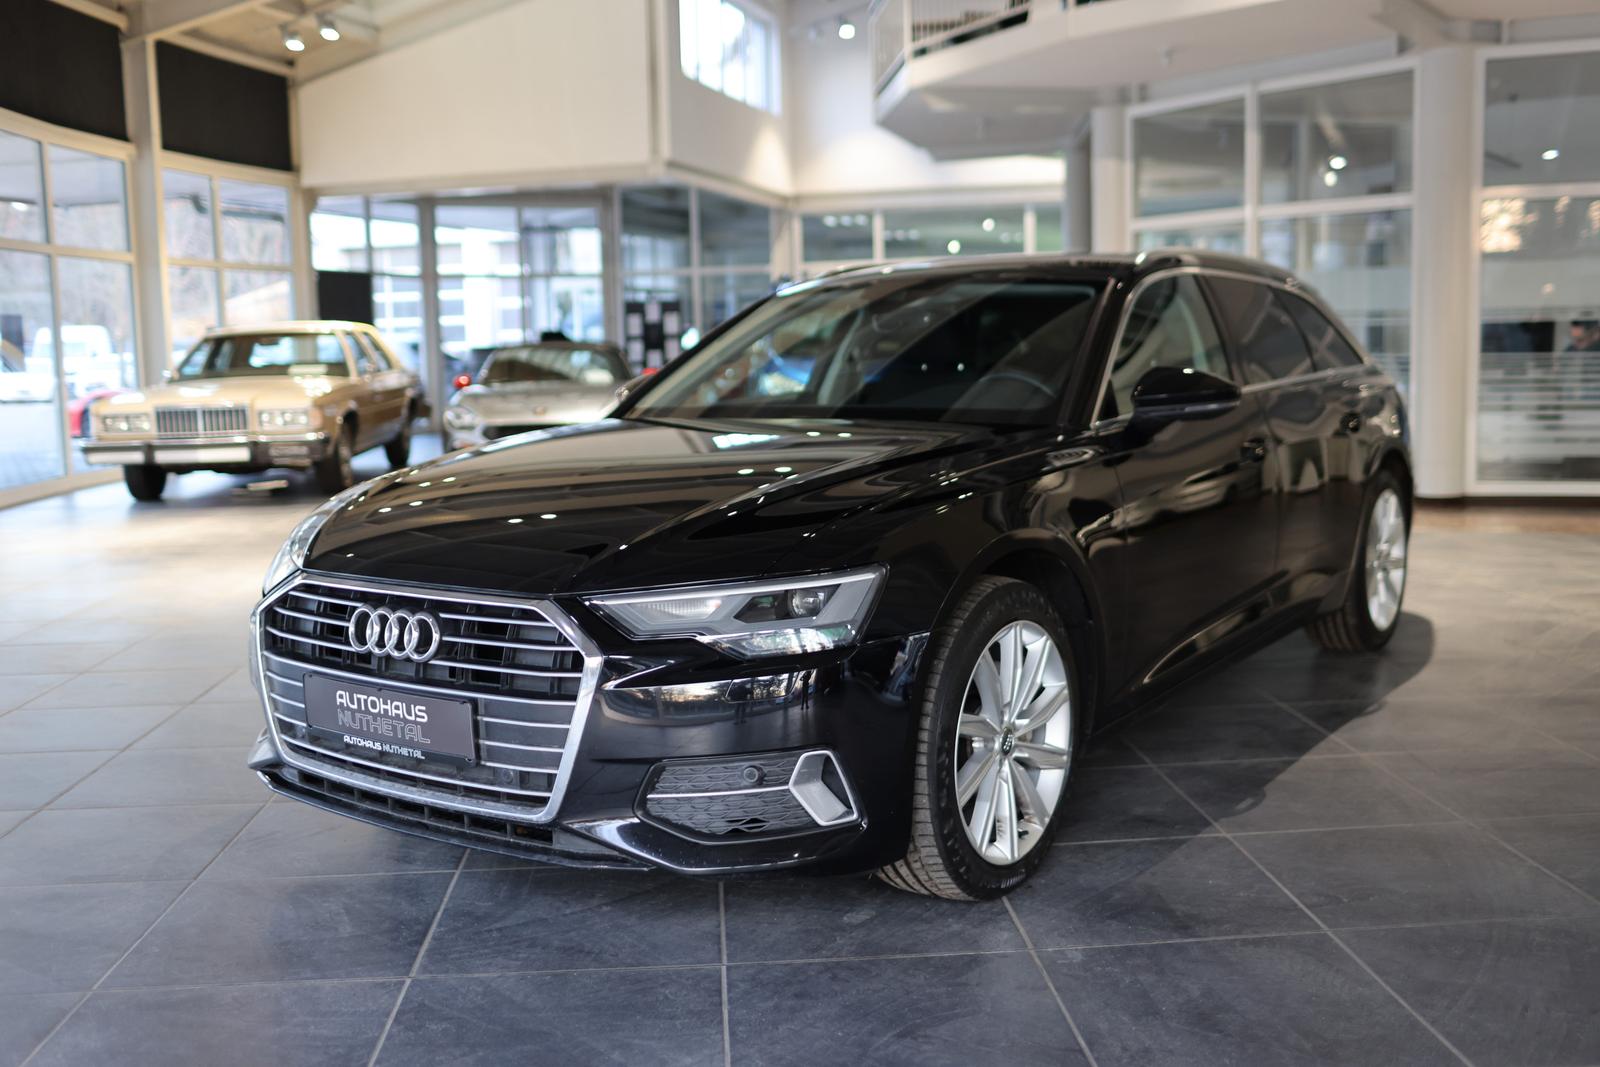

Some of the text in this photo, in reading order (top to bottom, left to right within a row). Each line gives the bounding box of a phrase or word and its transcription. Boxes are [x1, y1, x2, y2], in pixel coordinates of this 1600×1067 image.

[336, 690, 428, 723] AUTOHAUS
[337, 709, 430, 744] NUTHETAL
[343, 735, 425, 759] AUTOHAUS NUTHETAL
